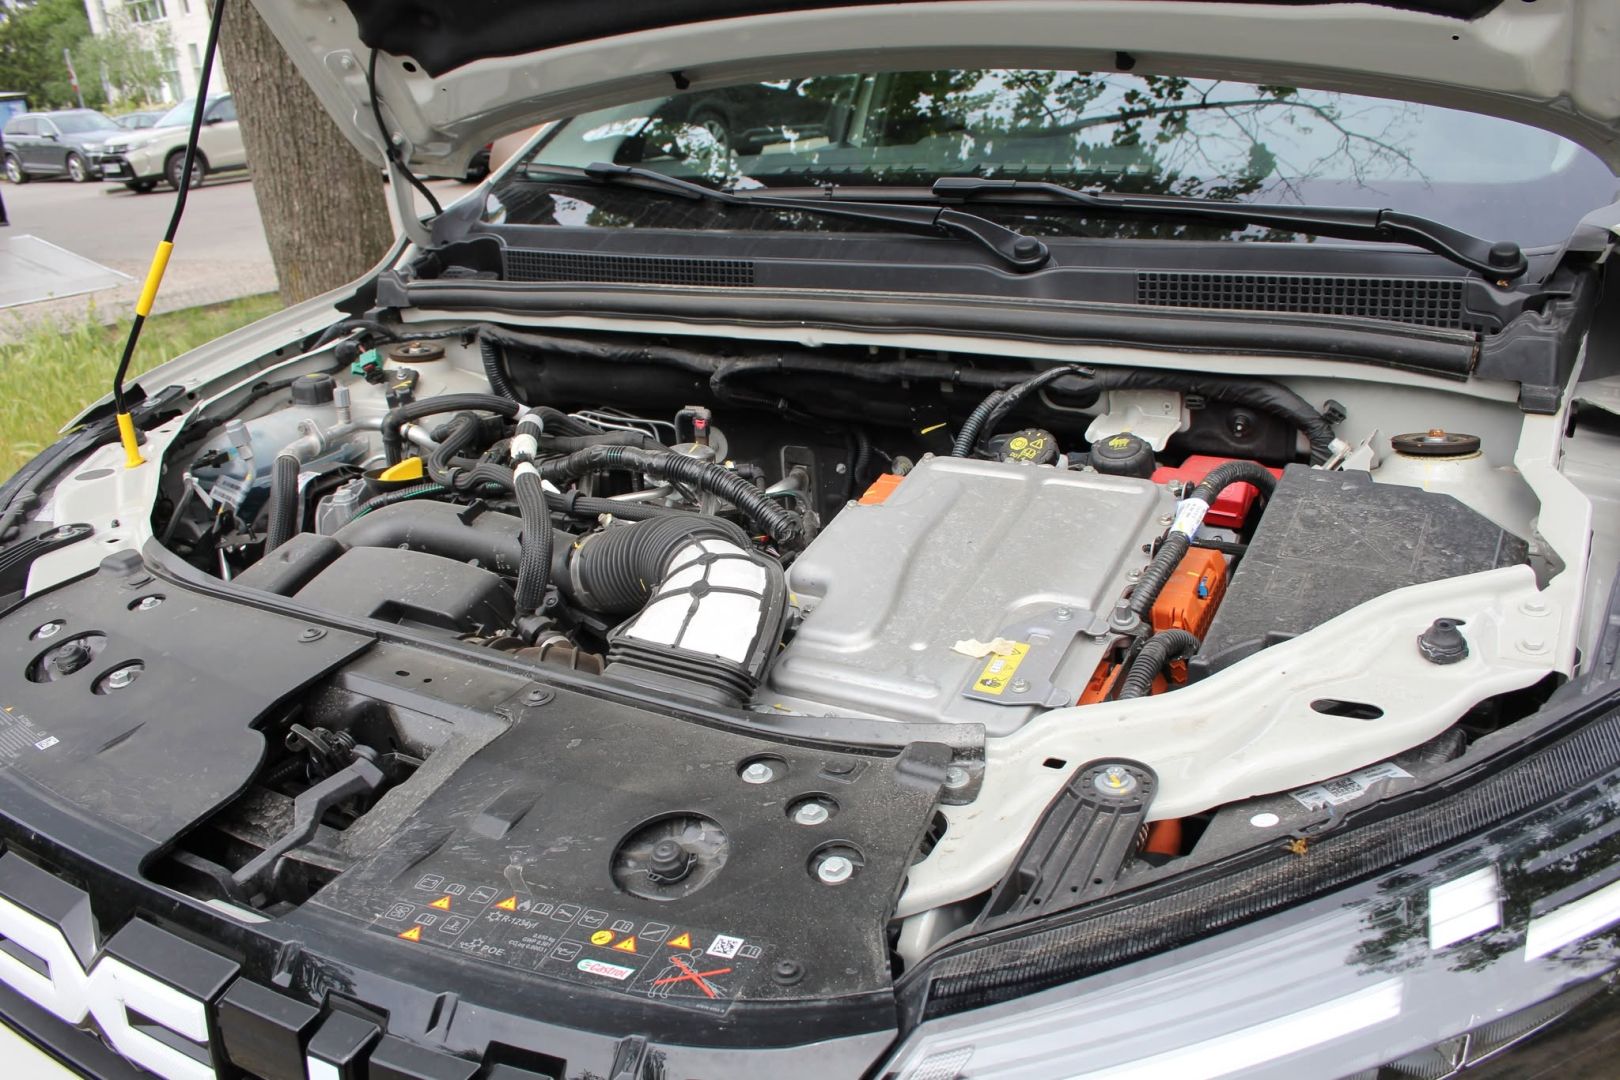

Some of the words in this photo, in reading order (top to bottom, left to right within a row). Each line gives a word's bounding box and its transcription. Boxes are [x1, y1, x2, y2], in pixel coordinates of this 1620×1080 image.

[501, 915, 539, 929] R-1234yf
[480, 945, 505, 956] POE
[589, 962, 629, 979] Castrol
